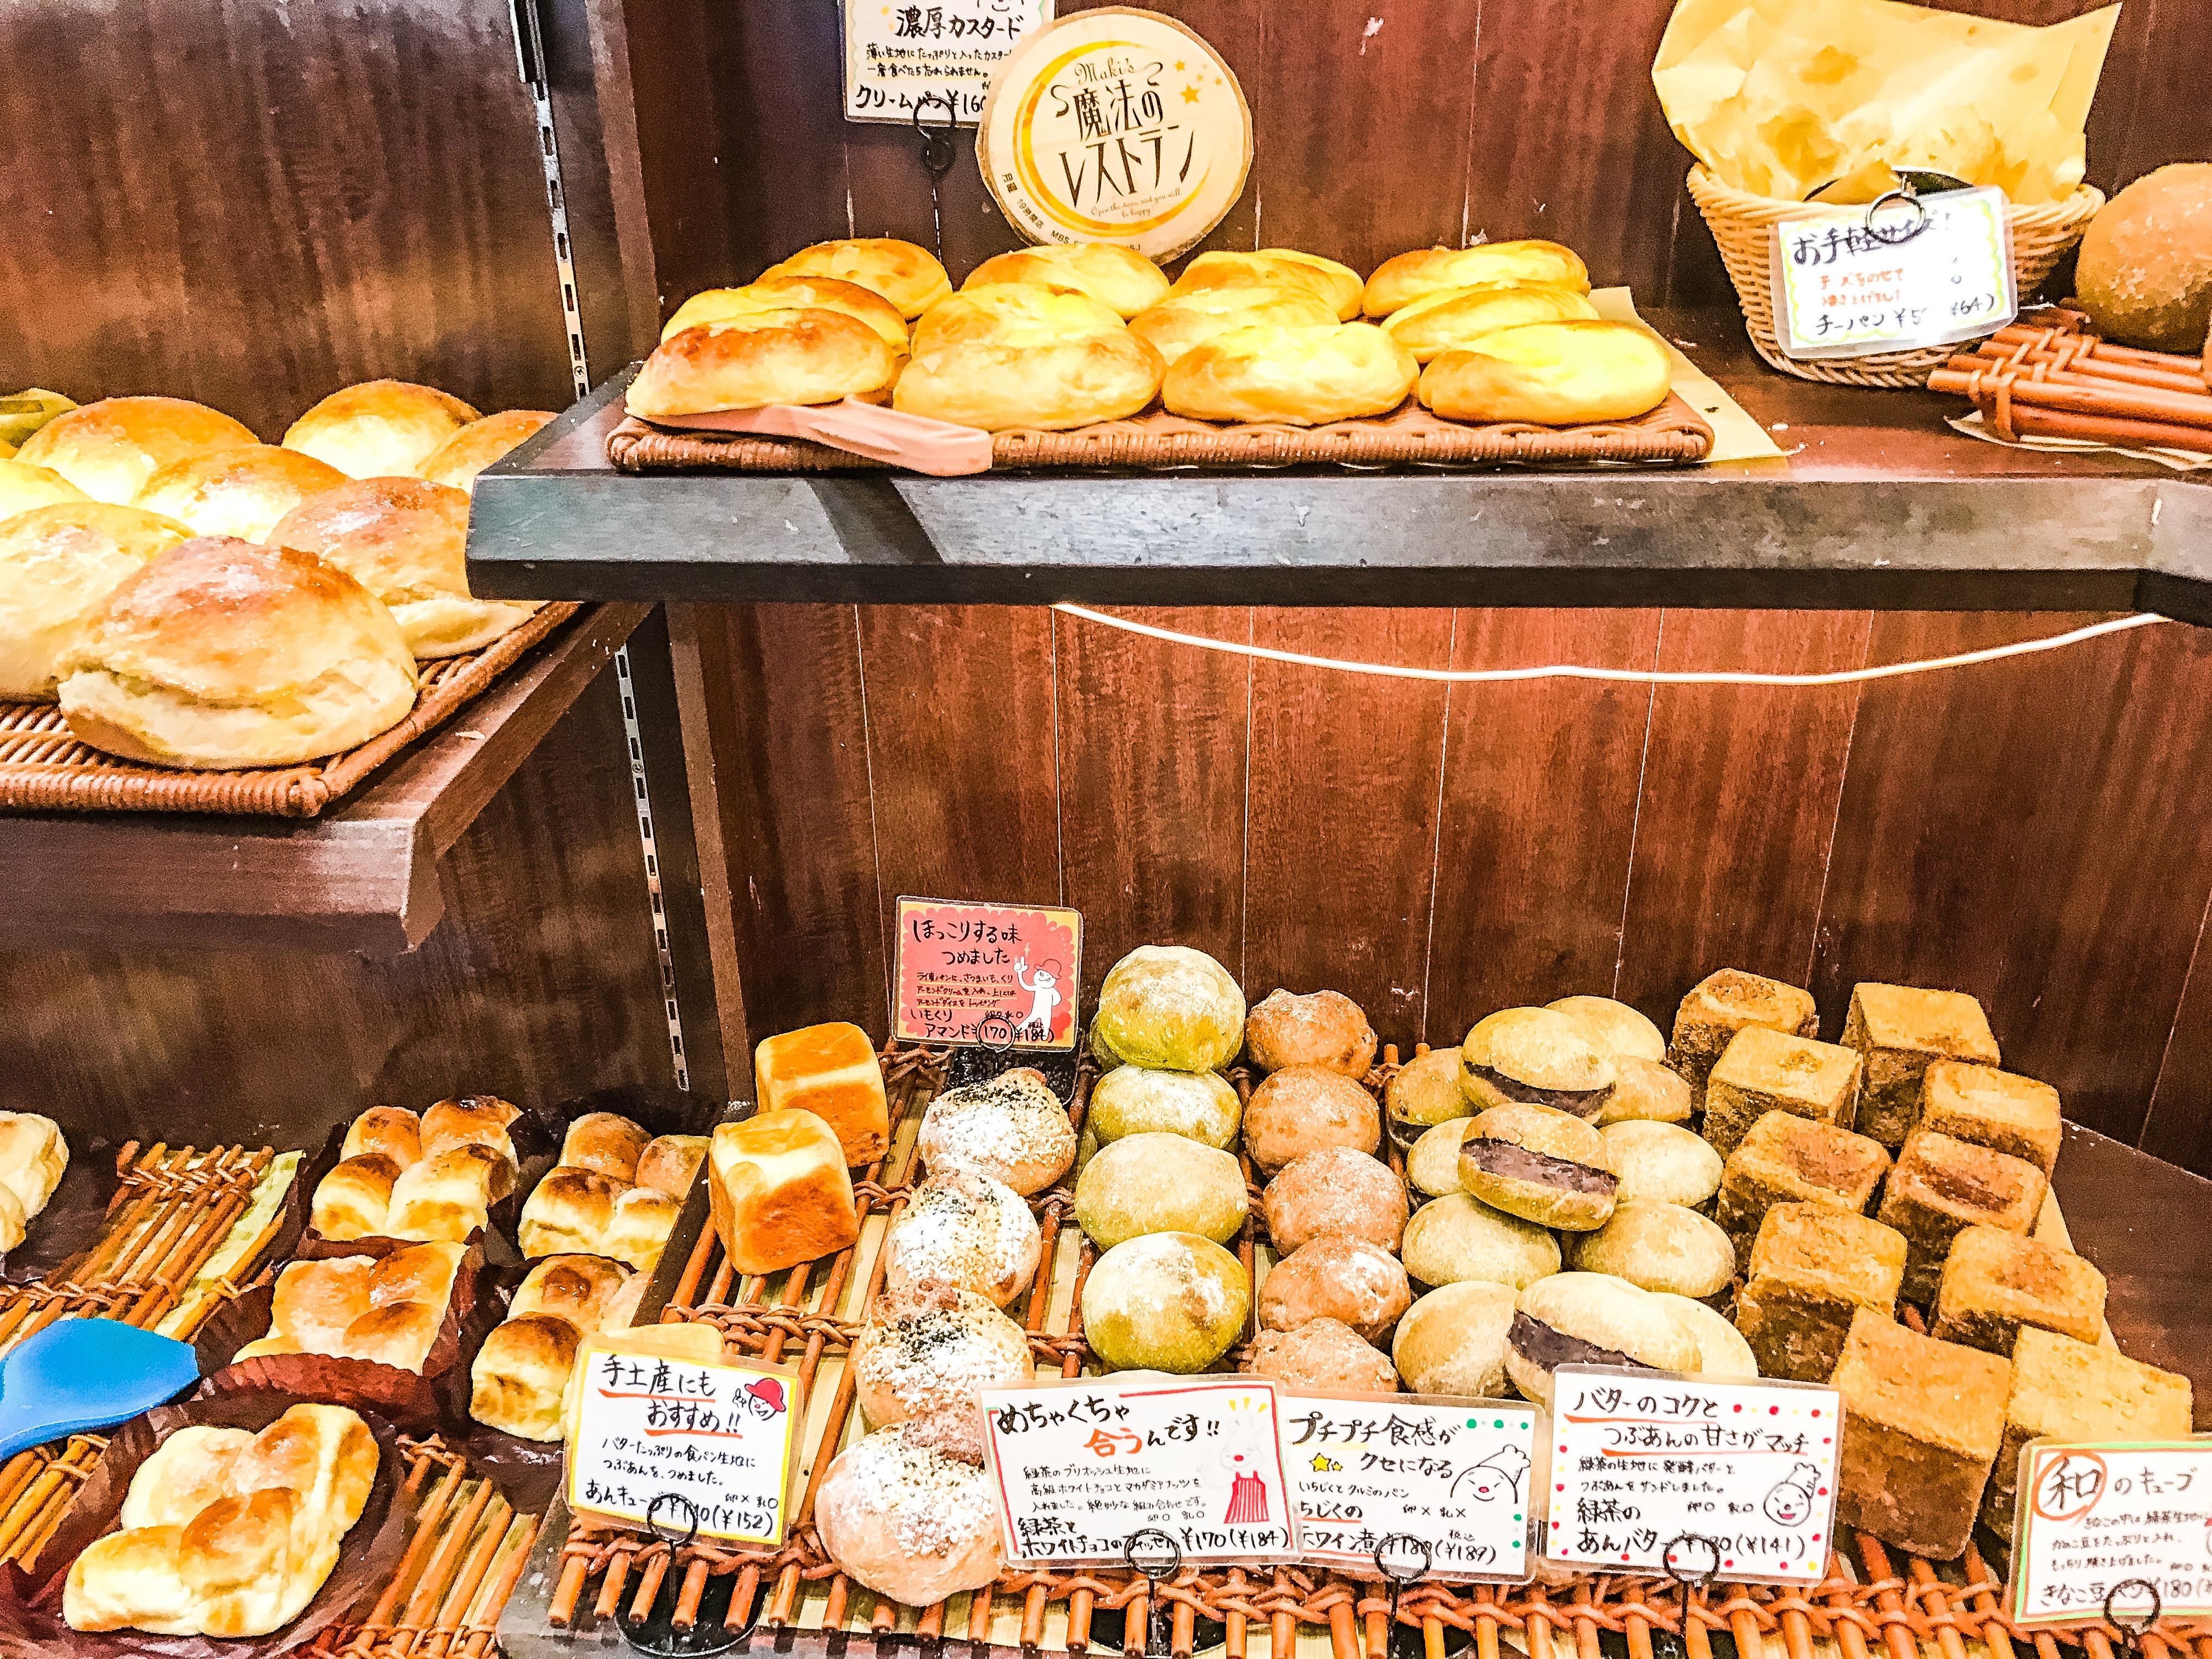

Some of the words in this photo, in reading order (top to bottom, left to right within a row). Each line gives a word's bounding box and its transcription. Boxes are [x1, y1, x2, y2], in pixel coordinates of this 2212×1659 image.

[895, 5, 1024, 41] 濃厚カスタード
[1074, 57, 1135, 85] Maki's
[1072, 79, 1163, 142] 魔法の
[1058, 125, 1195, 208] レストラン
[1050, 230, 1070, 245] MBS
[913, 919, 1022, 944] ほっこりする味
[941, 947, 1011, 965] つめました
[910, 1009, 953, 1023] いもくり
[925, 1023, 970, 1039] アマンド
[601, 1353, 716, 1397] 手土産にも
[996, 1395, 1130, 1435] めちゃくちゃ
[1573, 1386, 1719, 1418] バターのコクと
[647, 1400, 741, 1434] おすすめ!!
[1289, 1410, 1462, 1447] プチプチ食感が
[602, 1437, 756, 1468] バターたっぷりの食パン生地に
[1359, 1451, 1454, 1479] クセになる
[603, 1458, 724, 1486] つぶあんを、つめました。
[1023, 1463, 1152, 1480] 緑茶のブリオッシュ生地に
[1576, 1497, 1641, 1524] 緑茶の
[1018, 1516, 1077, 1537] 緑茶と
